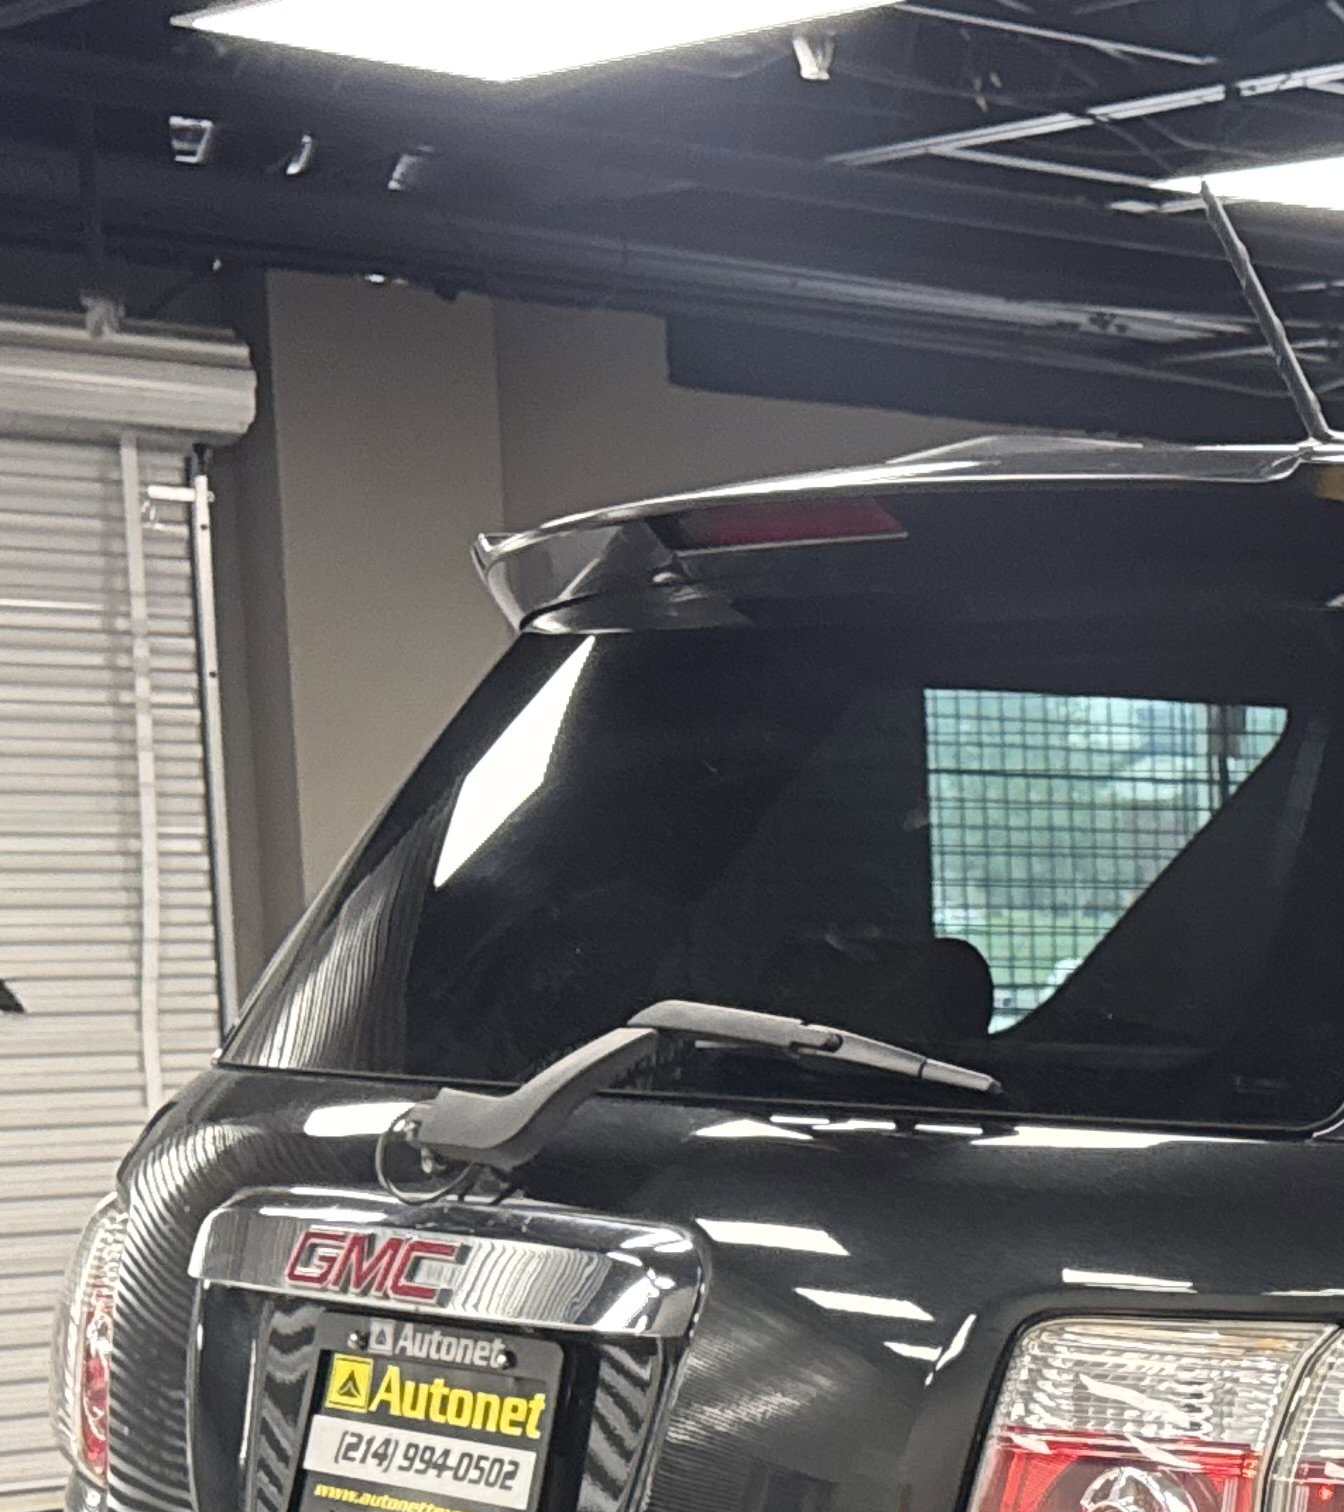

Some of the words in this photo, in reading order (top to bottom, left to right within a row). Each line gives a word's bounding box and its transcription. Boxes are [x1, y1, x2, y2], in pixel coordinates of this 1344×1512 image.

[285, 1228, 464, 1304] GMC
[394, 1323, 505, 1369] Autonet
[367, 1364, 546, 1440] Autonet
[333, 1429, 399, 1473] (214)
[397, 1441, 520, 1492] 994-0502
